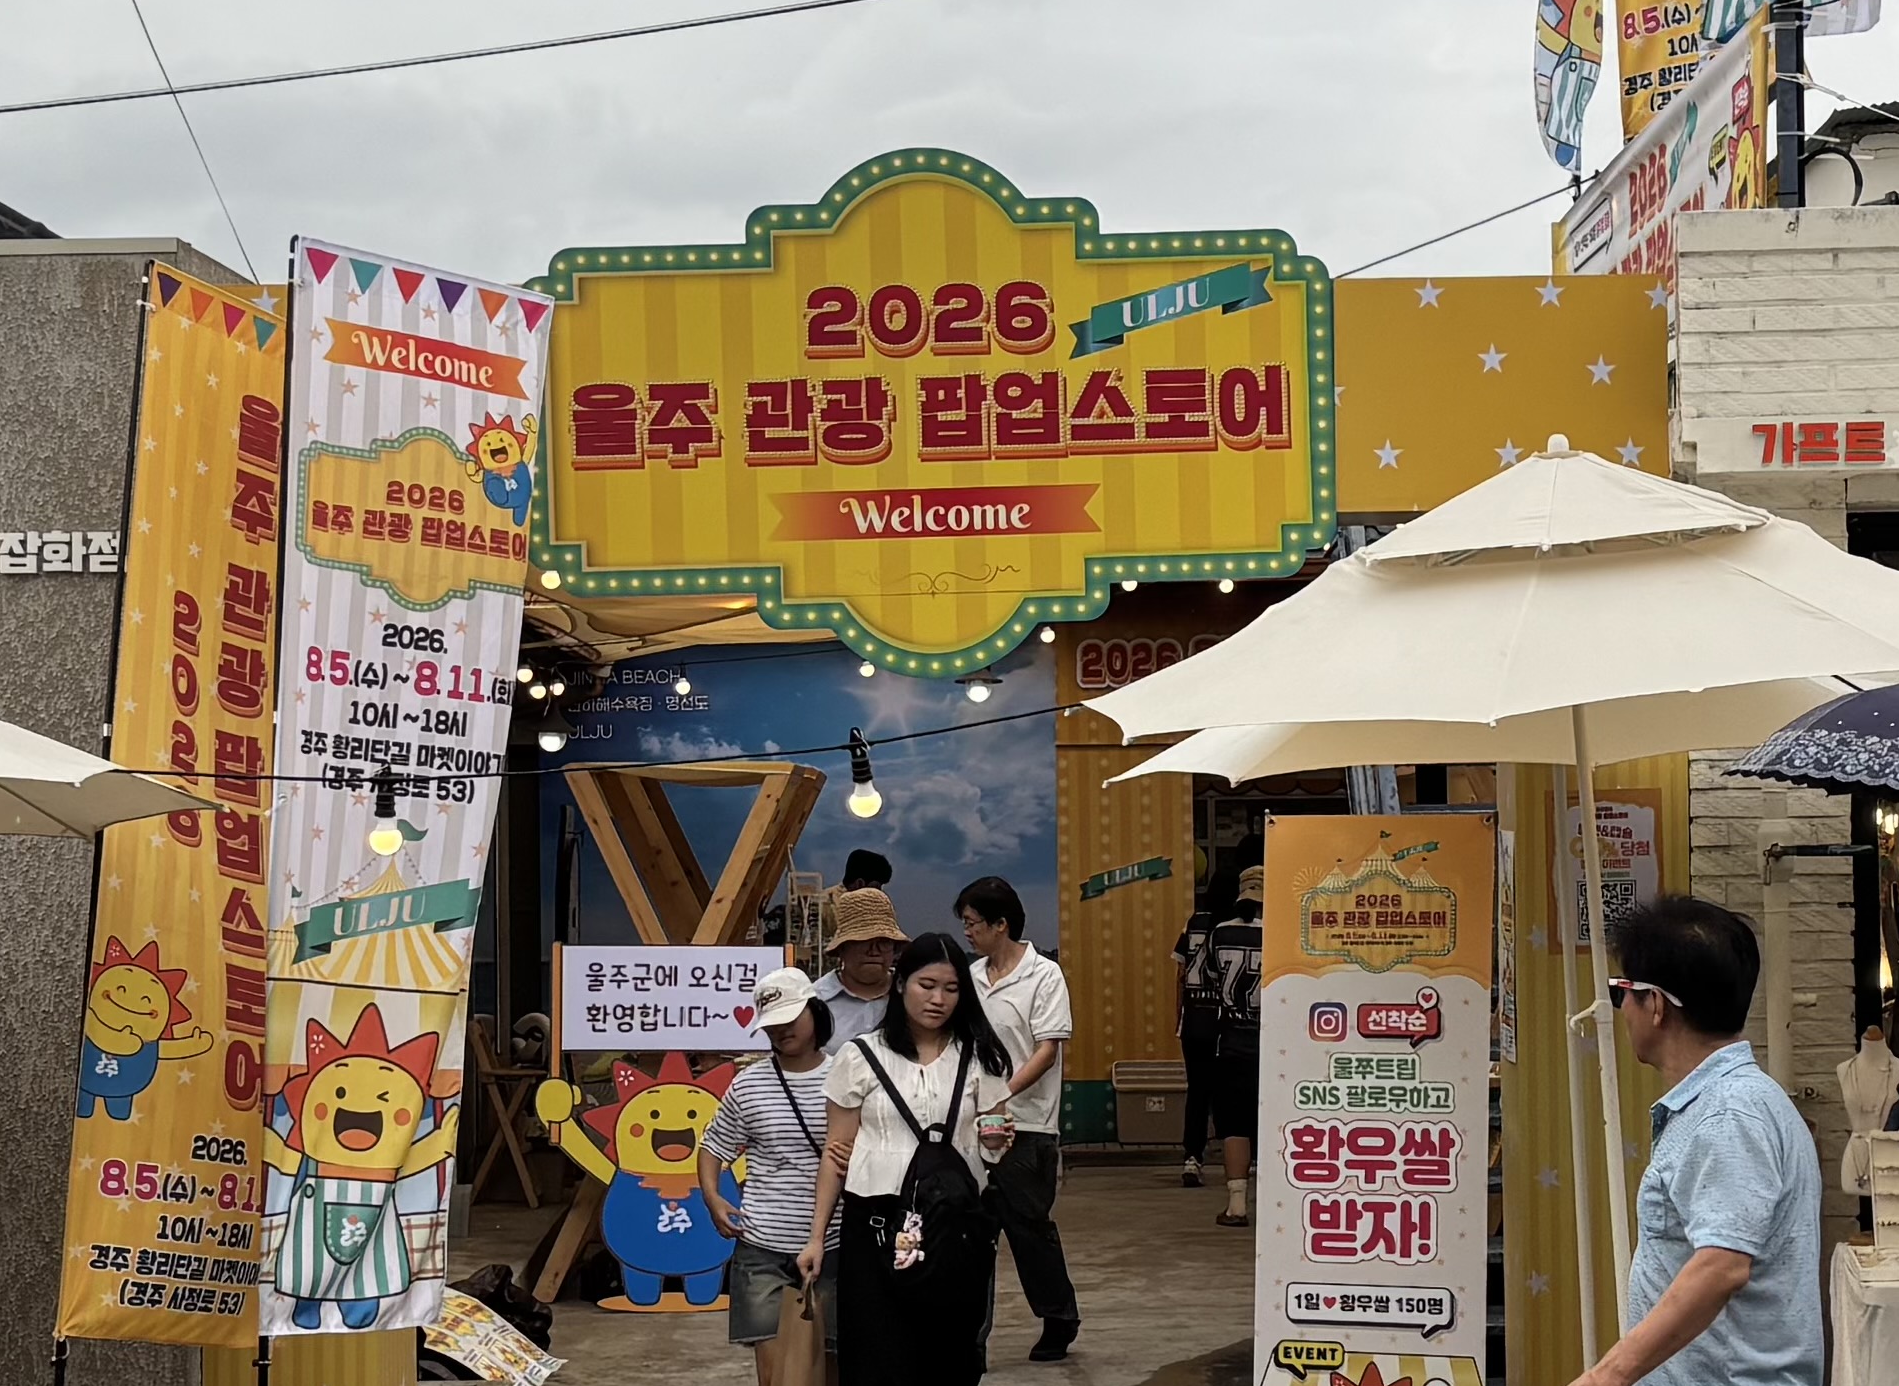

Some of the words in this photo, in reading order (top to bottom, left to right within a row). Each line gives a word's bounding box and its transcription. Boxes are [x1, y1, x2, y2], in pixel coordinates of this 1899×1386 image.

[1628, 143, 1669, 241] 2026
[803, 280, 1057, 358] 2026
[1121, 275, 1215, 327] ULJU
[351, 330, 495, 388] Welcome
[569, 378, 723, 470] 울주
[744, 372, 895, 467] 관광
[917, 362, 1291, 462] 팝업스토어
[230, 394, 284, 546] 울주
[386, 480, 466, 515] 2026
[838, 493, 1033, 538] Welcome
[312, 499, 355, 535] 울주
[362, 509, 414, 544] 관광
[420, 515, 527, 563] 팝업스토어
[210, 562, 273, 719] 관광
[382, 623, 448, 654] 2026.
[568, 670, 618, 685] JINA
[622, 668, 681, 685] BEACH
[348, 700, 399, 729] 10시
[665, 695, 709, 712] 명선도
[301, 729, 329, 756] 경주
[332, 733, 412, 766] 황리단길
[332, 890, 428, 939] ULJU
[1355, 894, 1402, 909] 2026
[585, 962, 679, 993] 울주군에
[1367, 1009, 1427, 1032] 선착순
[1298, 1085, 1341, 1106] SNS
[1346, 1085, 1451, 1109] 팔로우하고
[191, 1134, 248, 1165] 2026.
[1289, 1124, 1457, 1189] 황우쌀
[156, 1214, 204, 1244] 10시
[1308, 1198, 1432, 1259] 받자!
[89, 1244, 132, 1272] 경주
[134, 1247, 209, 1281] 황리단길
[208, 1258, 262, 1287] 마켓이야
[119, 1278, 167, 1308] (경주
[166, 1285, 217, 1313] 사정로
[217, 1291, 246, 1316] 53)
[1294, 1293, 1321, 1311] 1일
[1339, 1294, 1390, 1313] 황우쌀
[1395, 1297, 1444, 1315] 150명
[1283, 1345, 1339, 1361] EVENT
